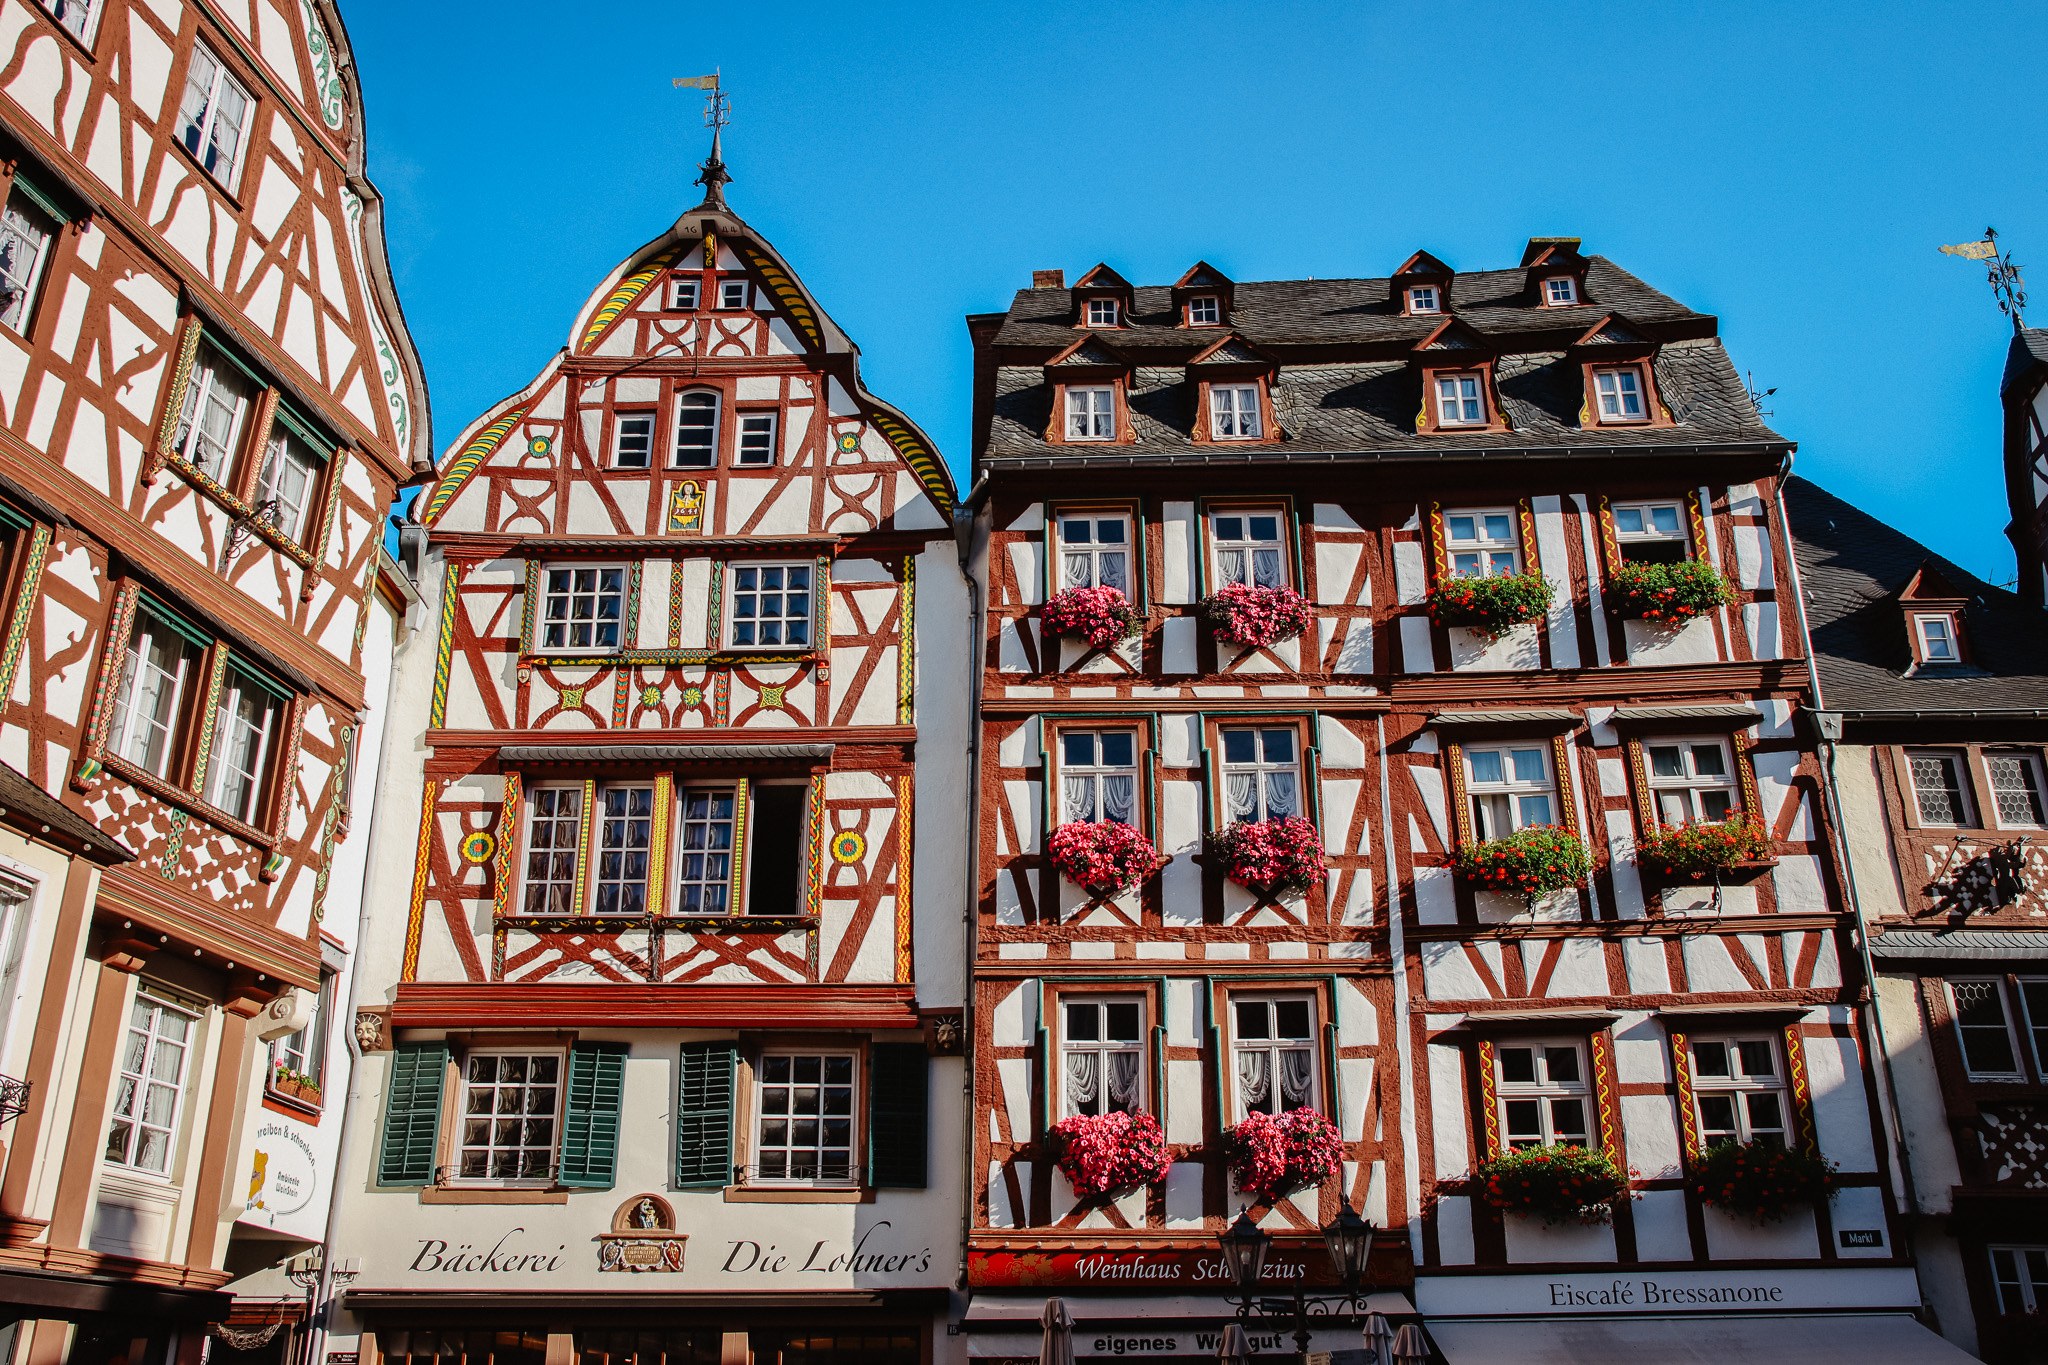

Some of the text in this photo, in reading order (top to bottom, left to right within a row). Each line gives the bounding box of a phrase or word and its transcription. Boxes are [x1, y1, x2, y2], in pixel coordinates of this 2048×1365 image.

[685, 226, 697, 234] 16
[283, 1125, 289, 1138] &
[290, 1132, 315, 1166] schenken
[277, 1171, 299, 1186] Ambiente
[275, 1183, 298, 1197] WeinStein
[1848, 1232, 1874, 1244] Markt
[408, 1221, 932, 1273] Bäckerei Die Lohner's
[1074, 1256, 1306, 1280] Weinhaus Schzius
[1548, 1280, 1784, 1306] Eiscafé Bressanone
[949, 1325, 958, 1335] 15
[1094, 1335, 1177, 1354] eigenes
